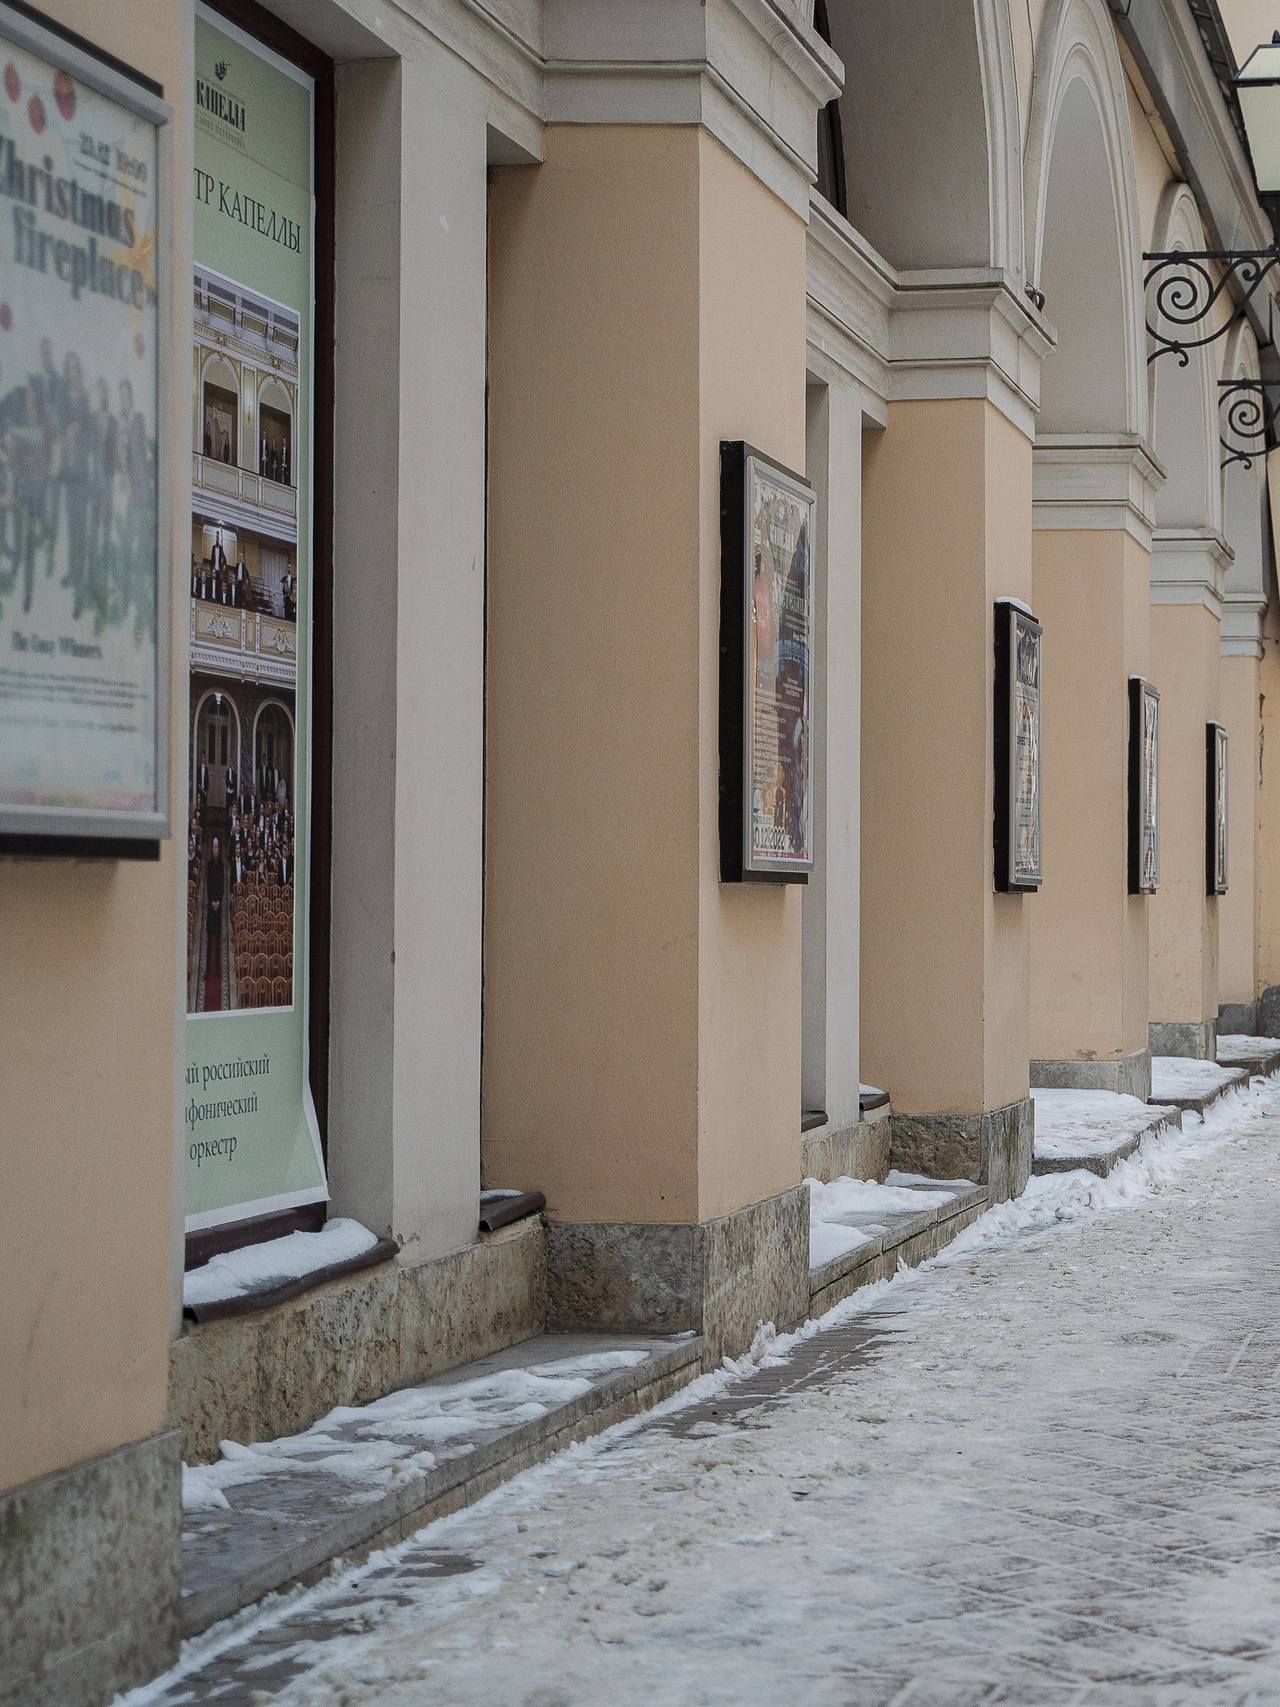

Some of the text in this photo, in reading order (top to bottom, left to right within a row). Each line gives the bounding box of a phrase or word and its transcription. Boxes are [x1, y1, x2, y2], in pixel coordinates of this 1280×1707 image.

[219, 181, 301, 254] КАПЕЛЛЫ
[202, 1053, 270, 1091] российский
[189, 1136, 237, 1168] оркестр
